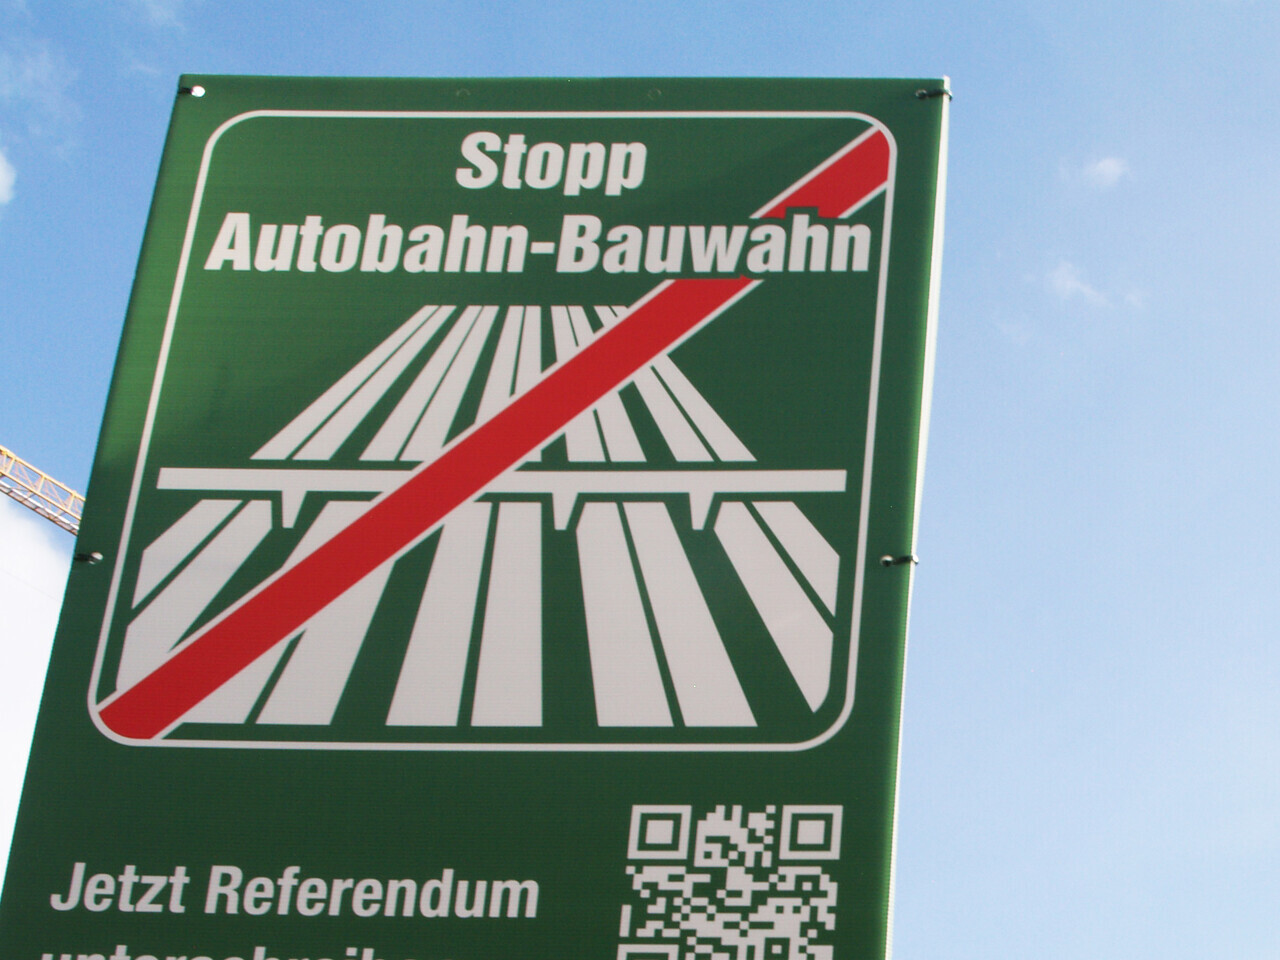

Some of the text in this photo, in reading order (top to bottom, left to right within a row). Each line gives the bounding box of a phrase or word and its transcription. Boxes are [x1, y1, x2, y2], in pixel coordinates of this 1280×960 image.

[455, 131, 647, 196] Stopp
[205, 209, 871, 274] Autobahn-Bauwahn
[49, 861, 540, 919] Jetzt Referendum
